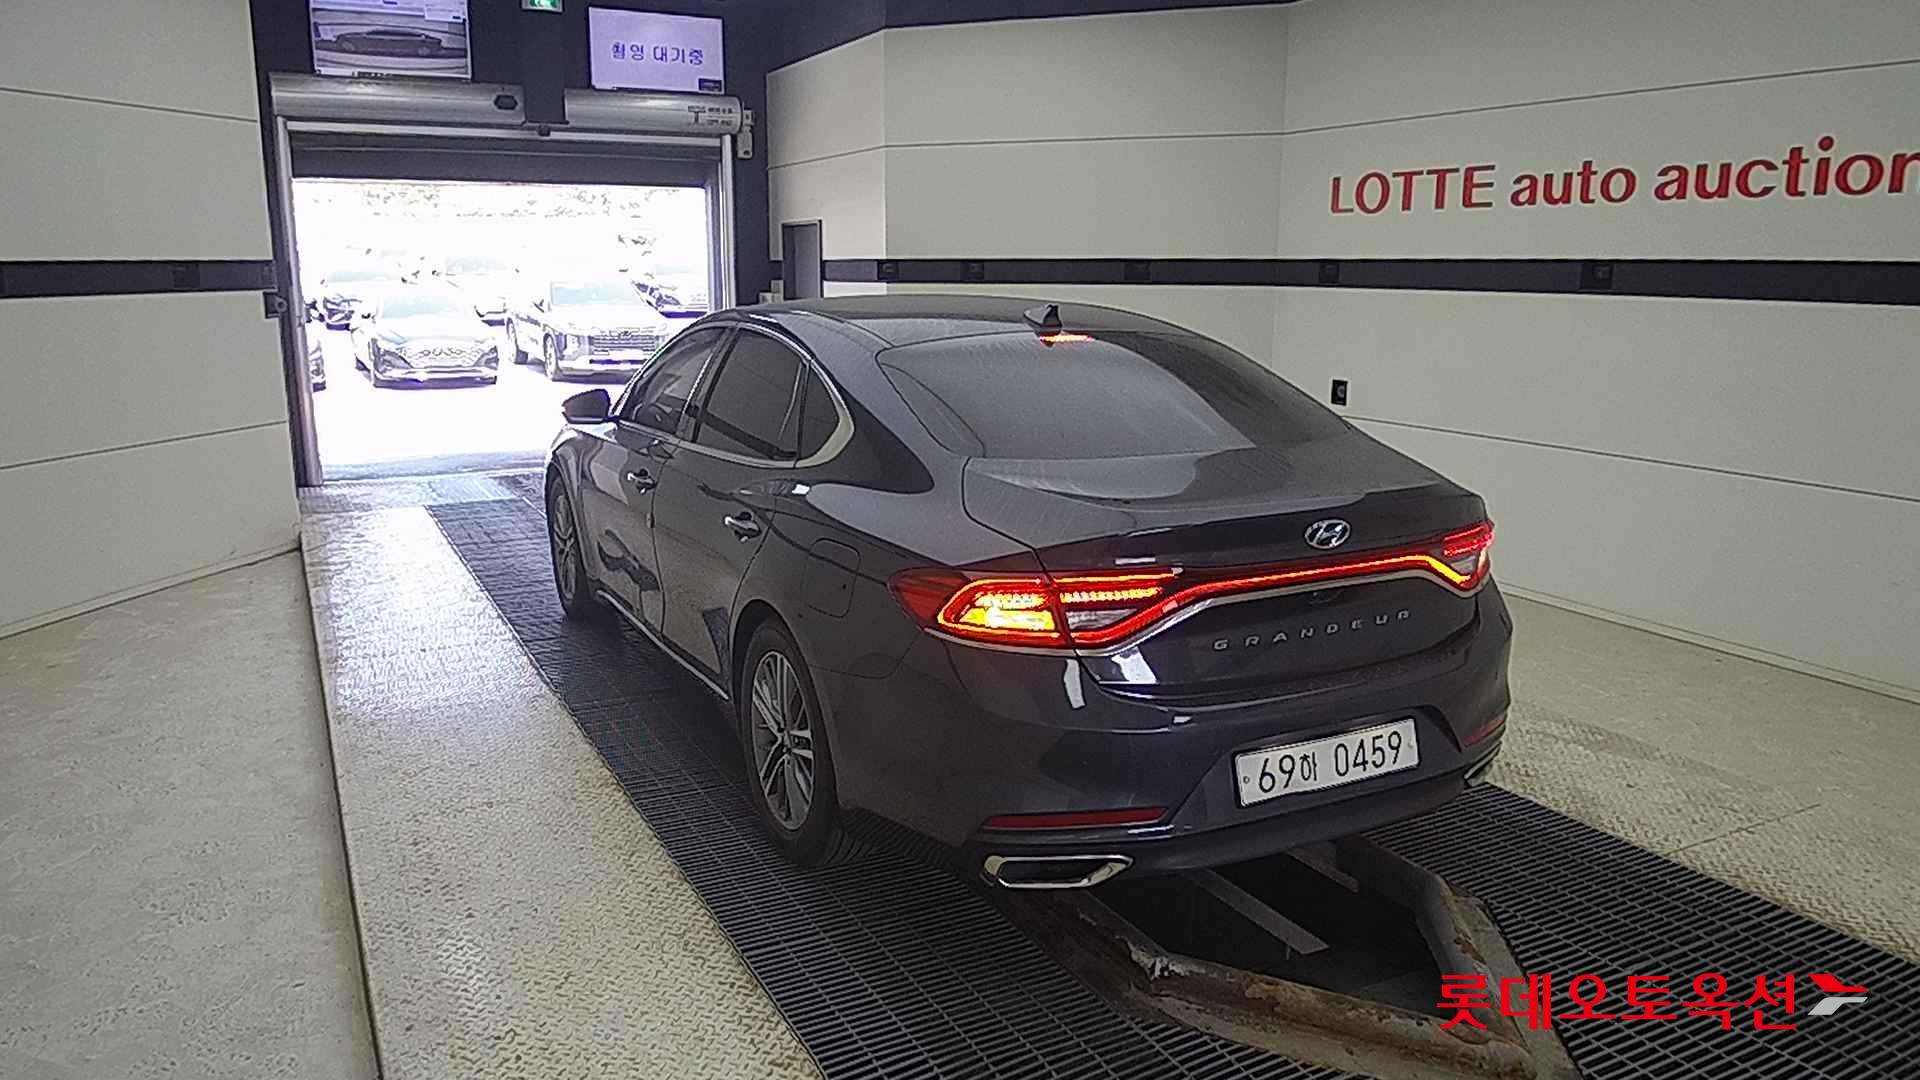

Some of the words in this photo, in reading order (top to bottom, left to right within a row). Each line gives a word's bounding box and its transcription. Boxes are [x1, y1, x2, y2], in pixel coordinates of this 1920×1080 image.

[653, 45, 704, 66] 대기중
[1330, 164, 1496, 215] LOTTE
[1510, 160, 1637, 207] auto
[1213, 609, 1411, 651] GRANDEUR
[1258, 752, 1318, 794] 69하
[1334, 731, 1402, 777] 0459
